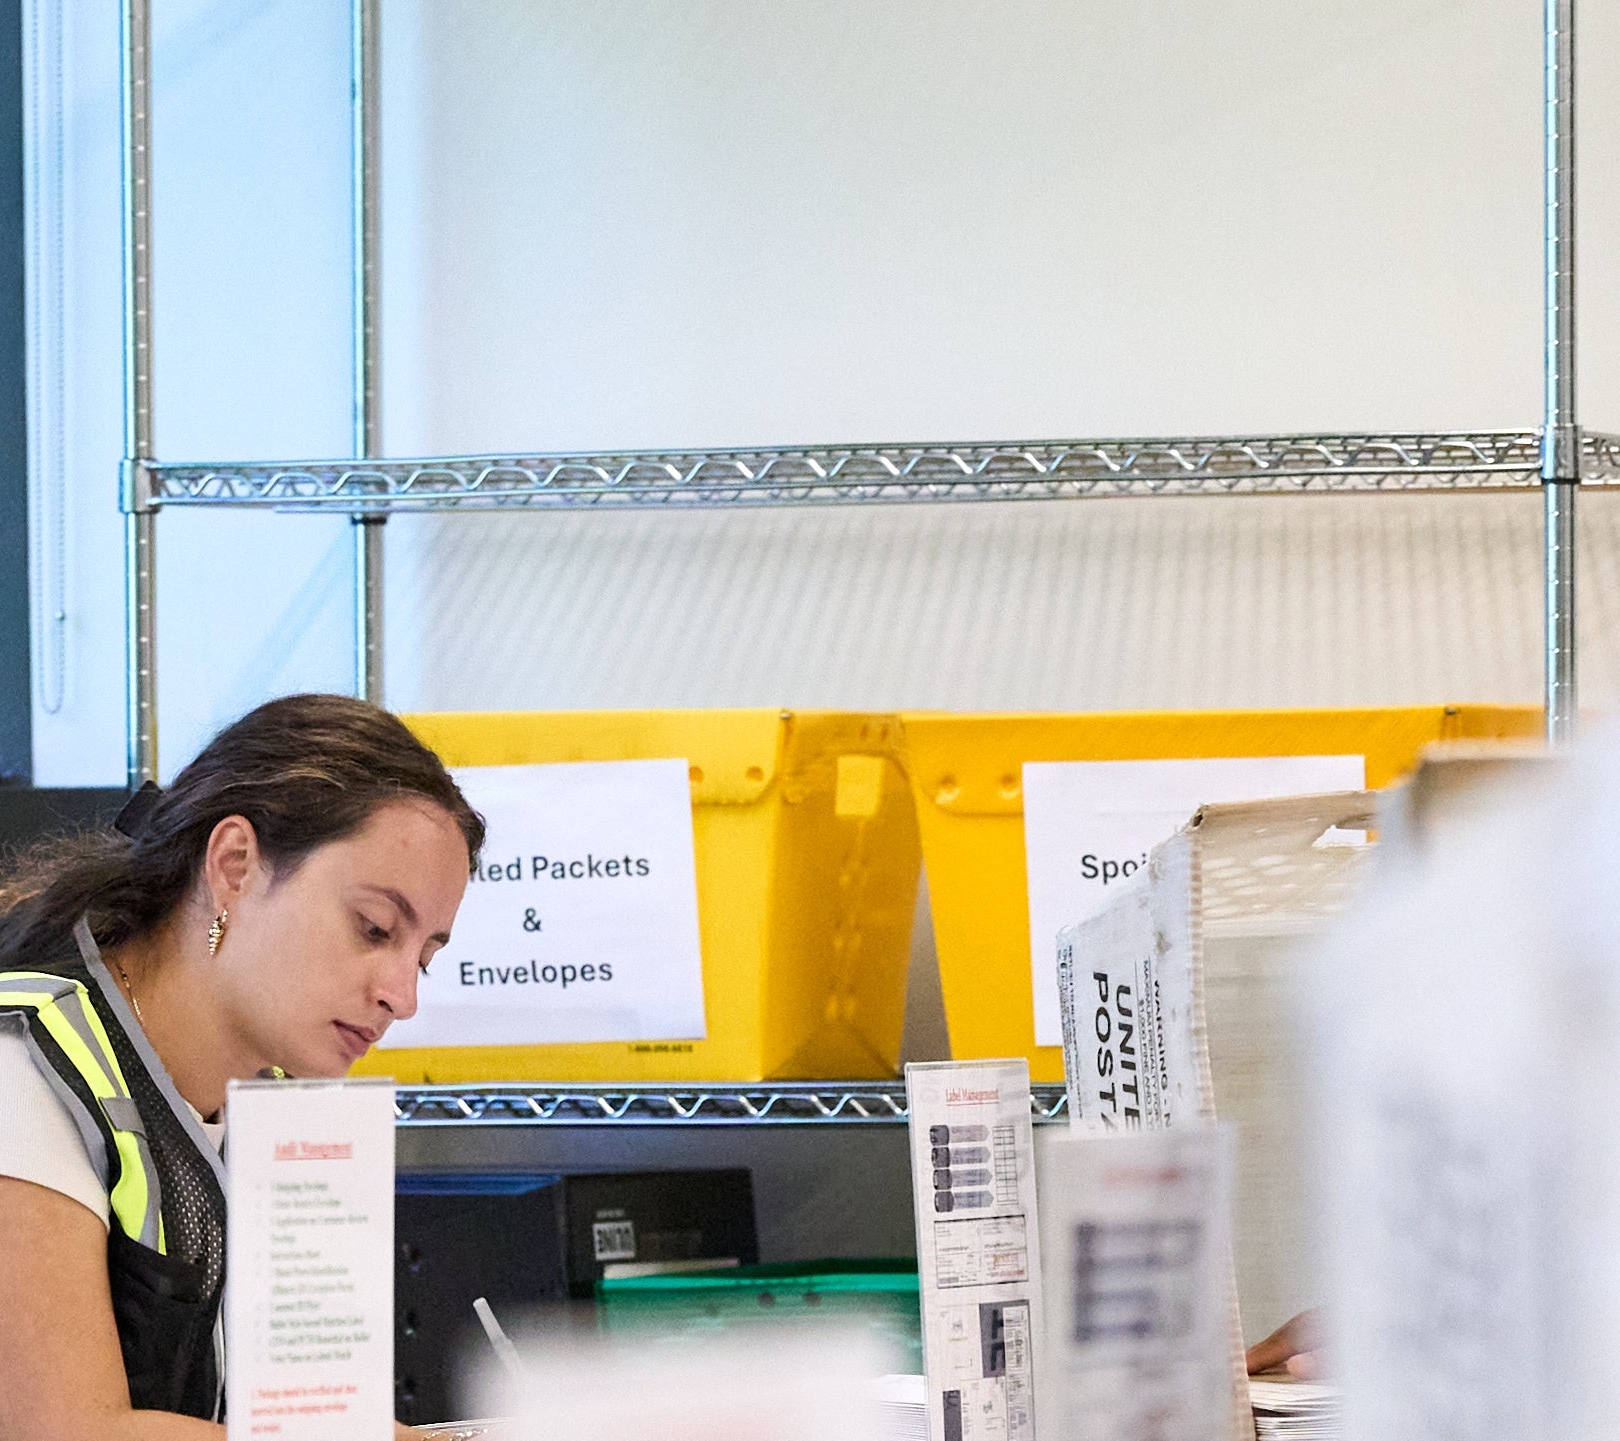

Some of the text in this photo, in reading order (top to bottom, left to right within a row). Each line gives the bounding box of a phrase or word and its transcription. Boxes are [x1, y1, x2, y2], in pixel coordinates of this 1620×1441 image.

[532, 854, 650, 880] Packets
[523, 908, 541, 931] &
[460, 960, 613, 988] Envelopes
[1093, 971, 1118, 1130] POST
[1116, 984, 1141, 1131] UNITE
